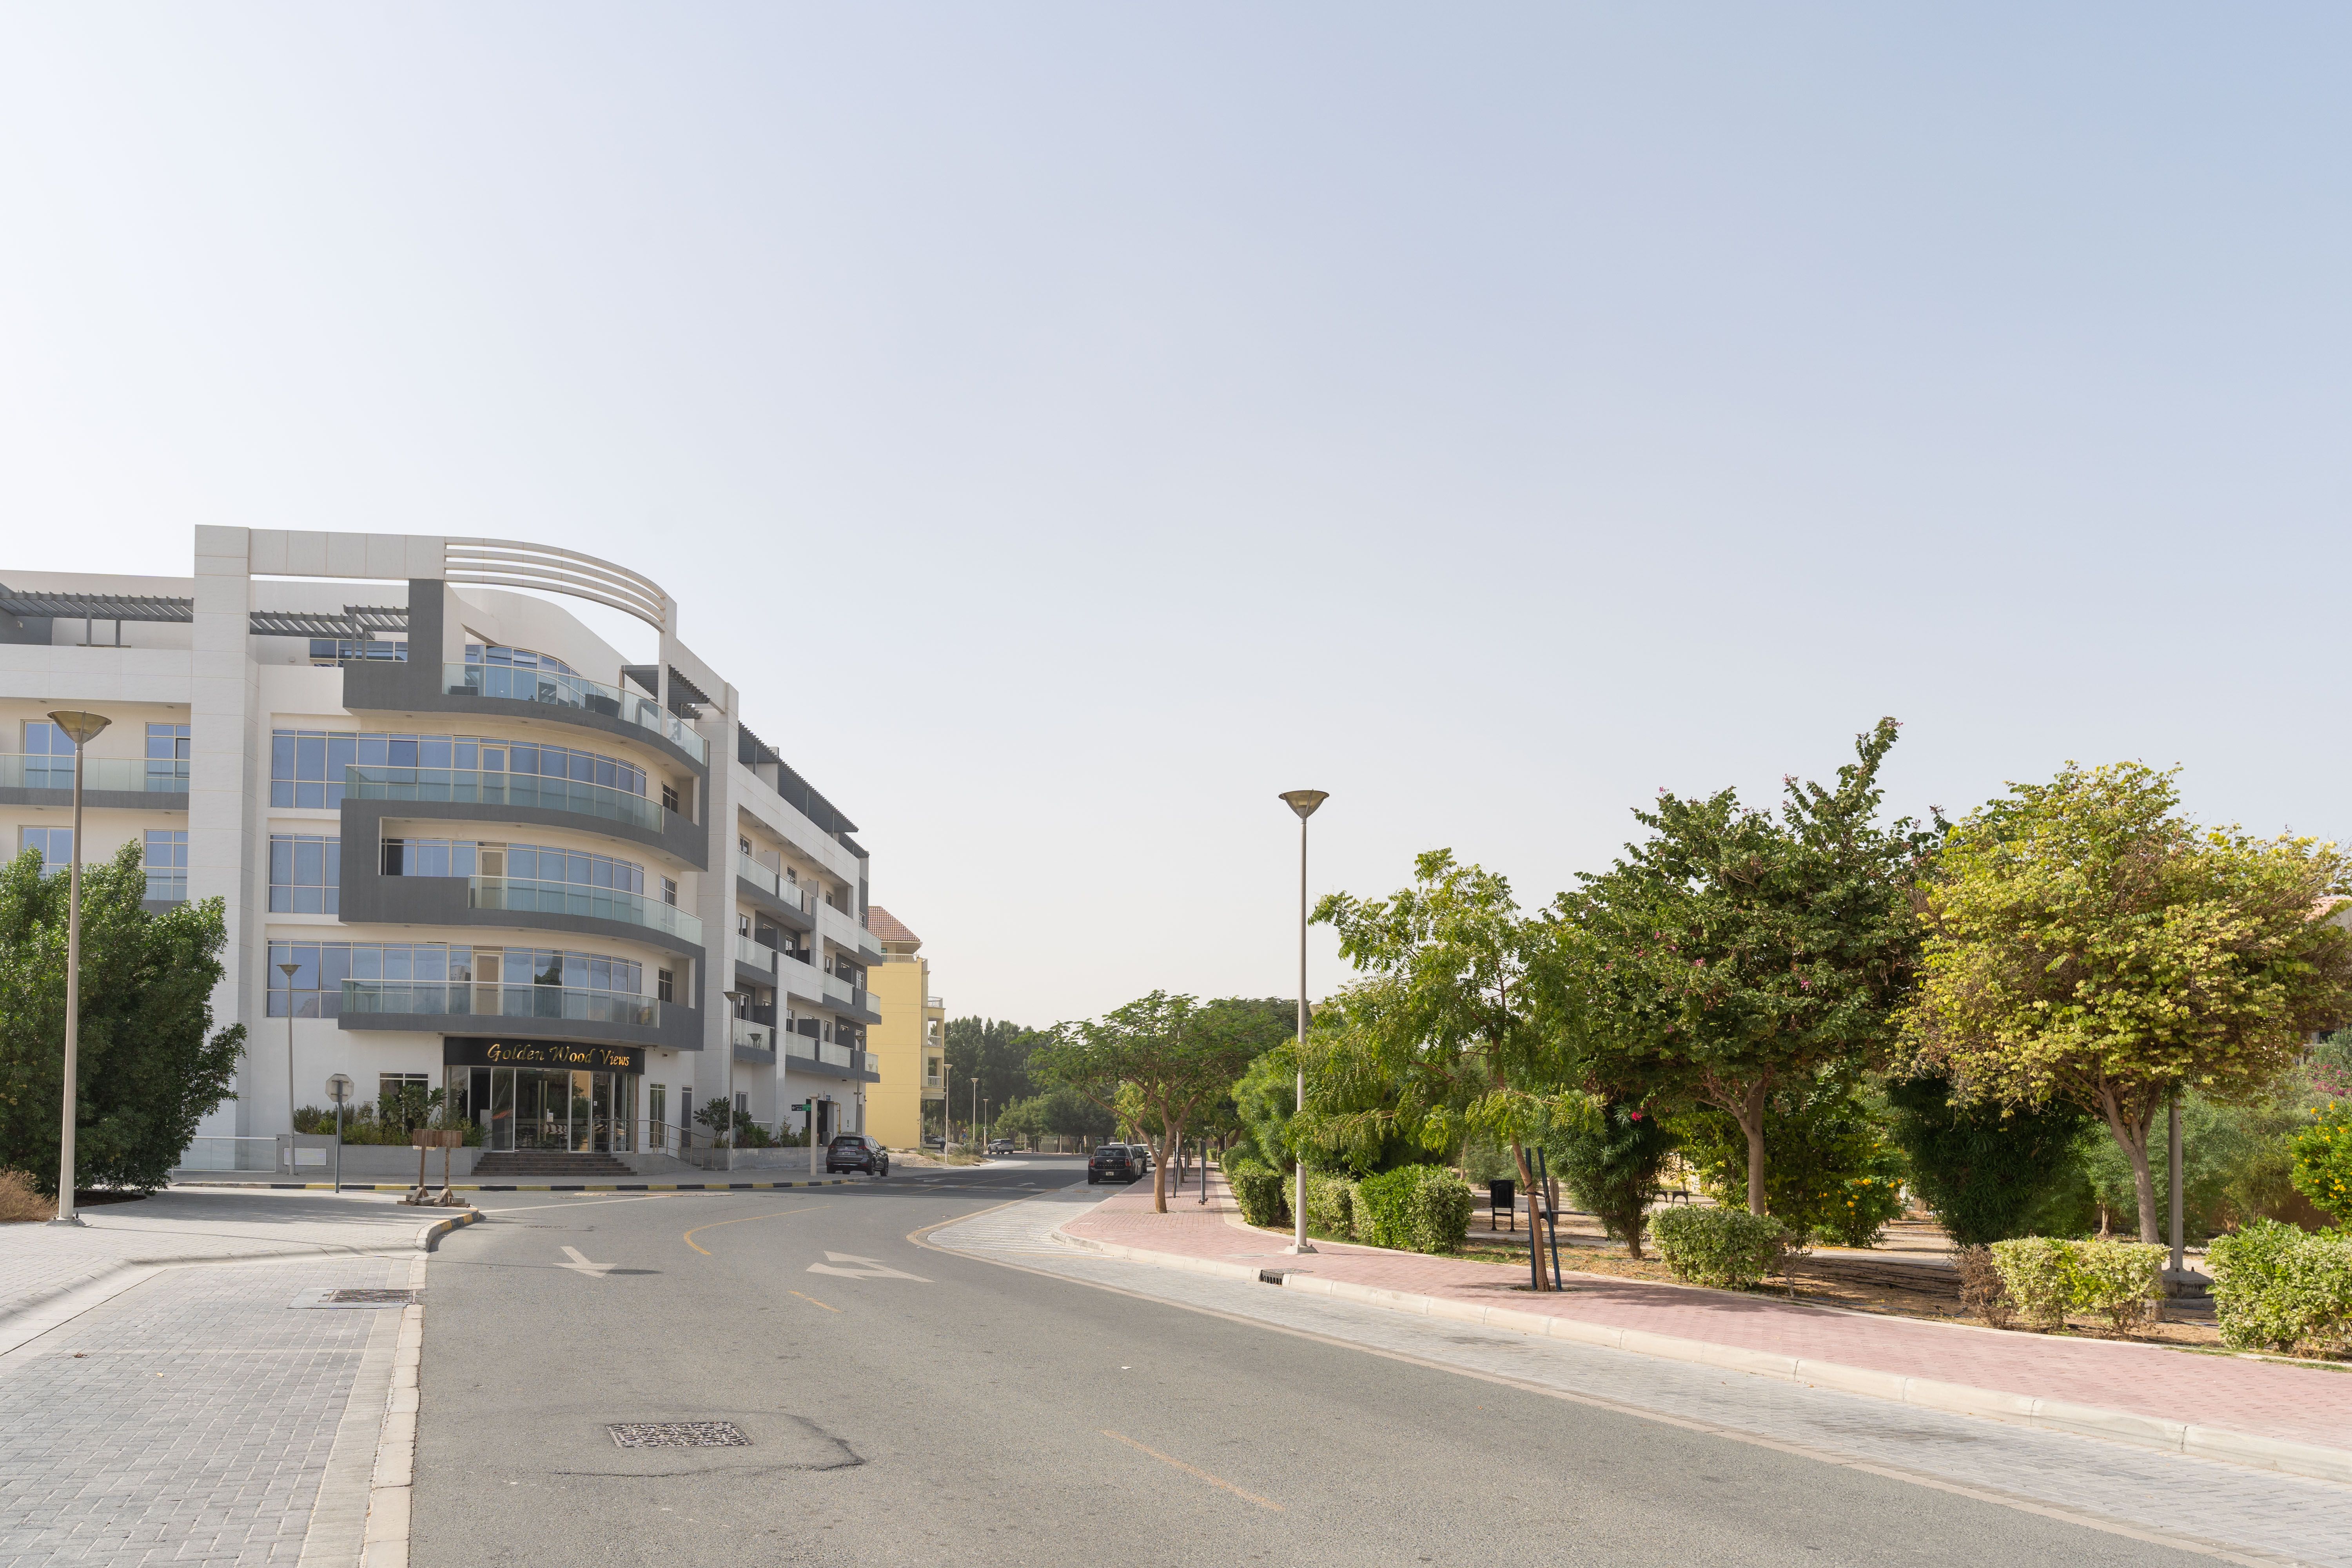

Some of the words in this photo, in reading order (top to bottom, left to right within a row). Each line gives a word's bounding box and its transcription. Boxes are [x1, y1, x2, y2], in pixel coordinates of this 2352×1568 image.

[487, 1043, 544, 1062] Golden
[549, 1046, 596, 1063] Wood
[599, 1049, 630, 1066] Views
